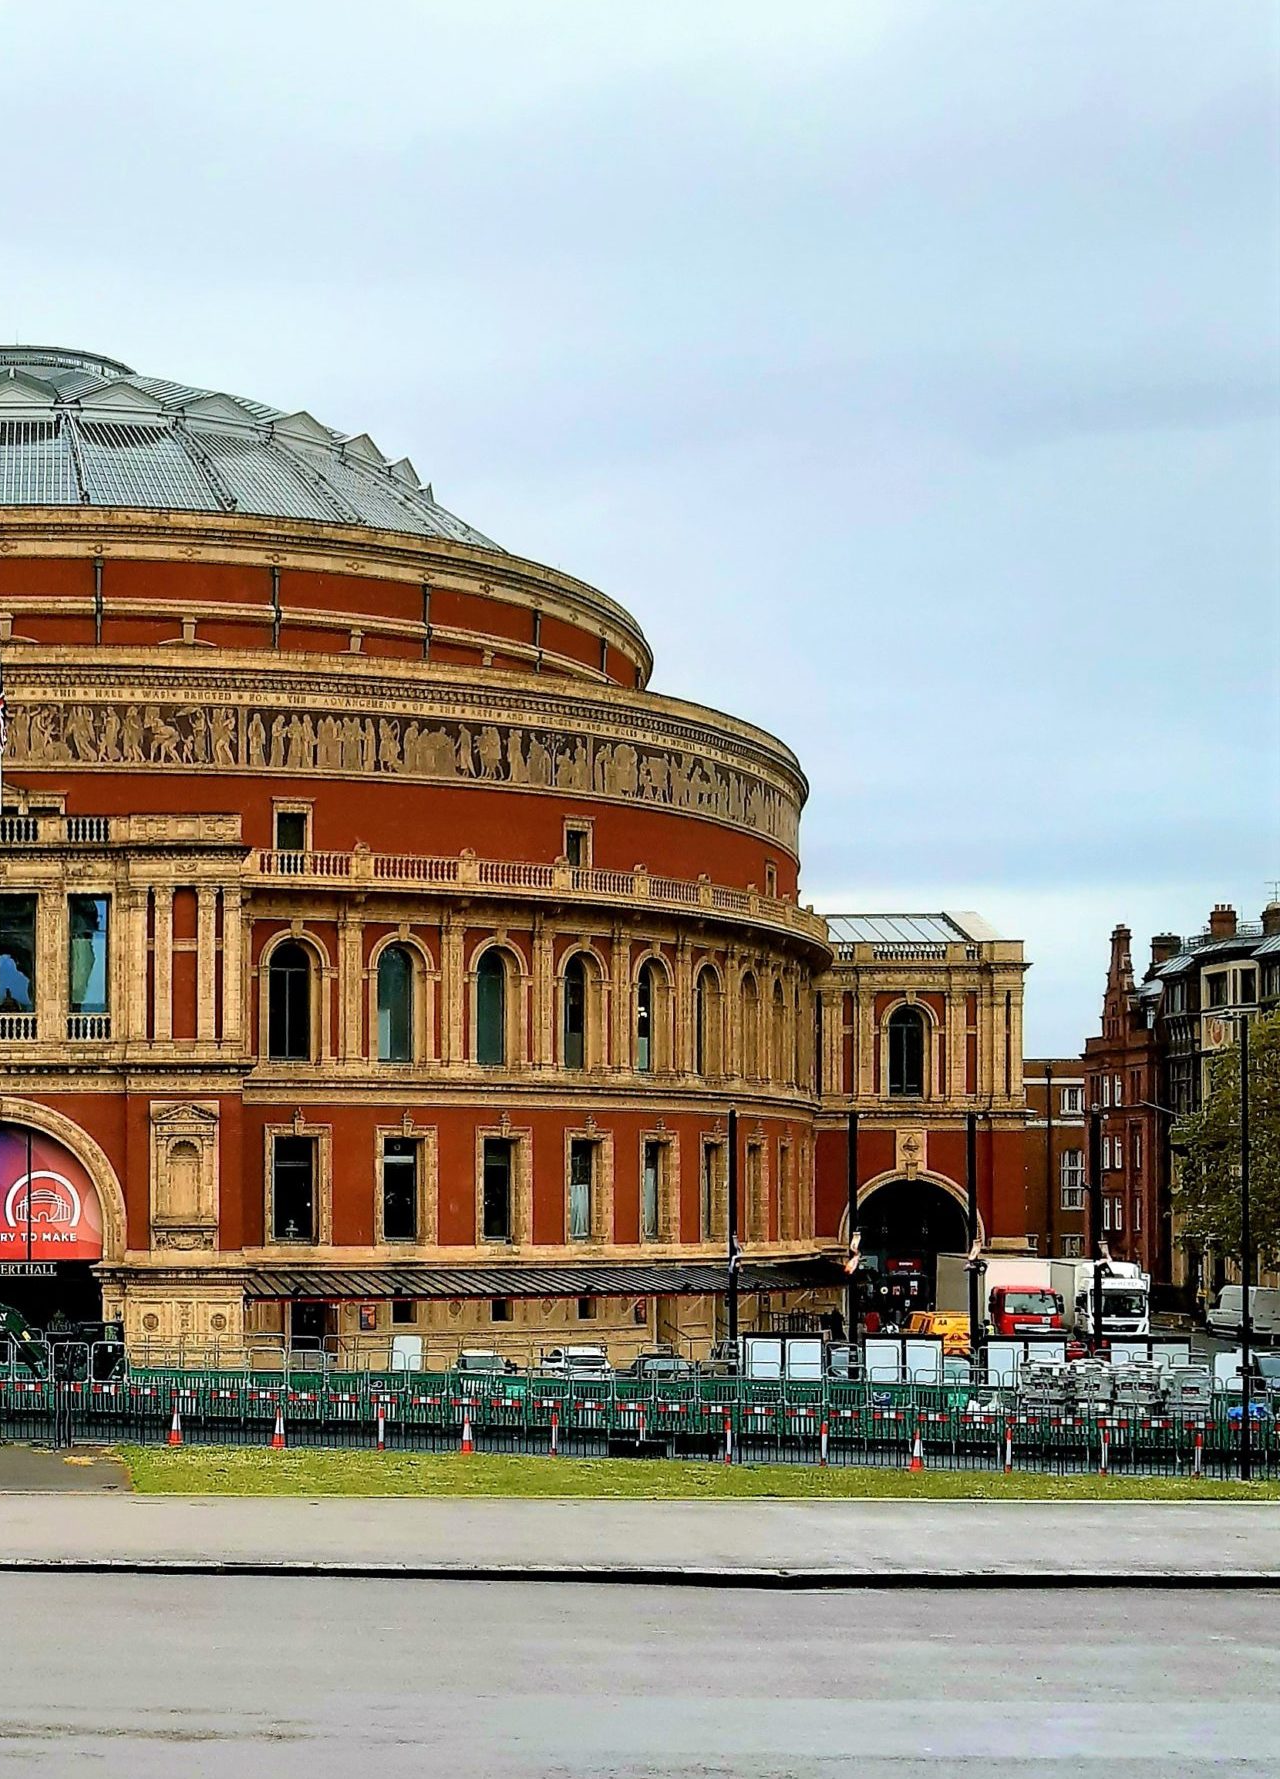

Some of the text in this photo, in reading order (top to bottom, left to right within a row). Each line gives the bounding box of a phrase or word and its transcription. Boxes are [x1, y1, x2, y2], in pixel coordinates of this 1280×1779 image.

[52, 689, 77, 698] THIS
[95, 689, 123, 698] HALL
[142, 690, 166, 699] WAS
[184, 691, 232, 701] ERECTED
[249, 693, 268, 702] FOR
[287, 694, 307, 704] THE
[323, 696, 397, 710] ADVANCEMENT
[412, 703, 424, 711] OF
[440, 704, 456, 714] THE
[506, 712, 524, 721] AND
[21, 1232, 38, 1242] TO
[42, 1232, 77, 1242] MAKE
[25, 1264, 57, 1275] HALL
